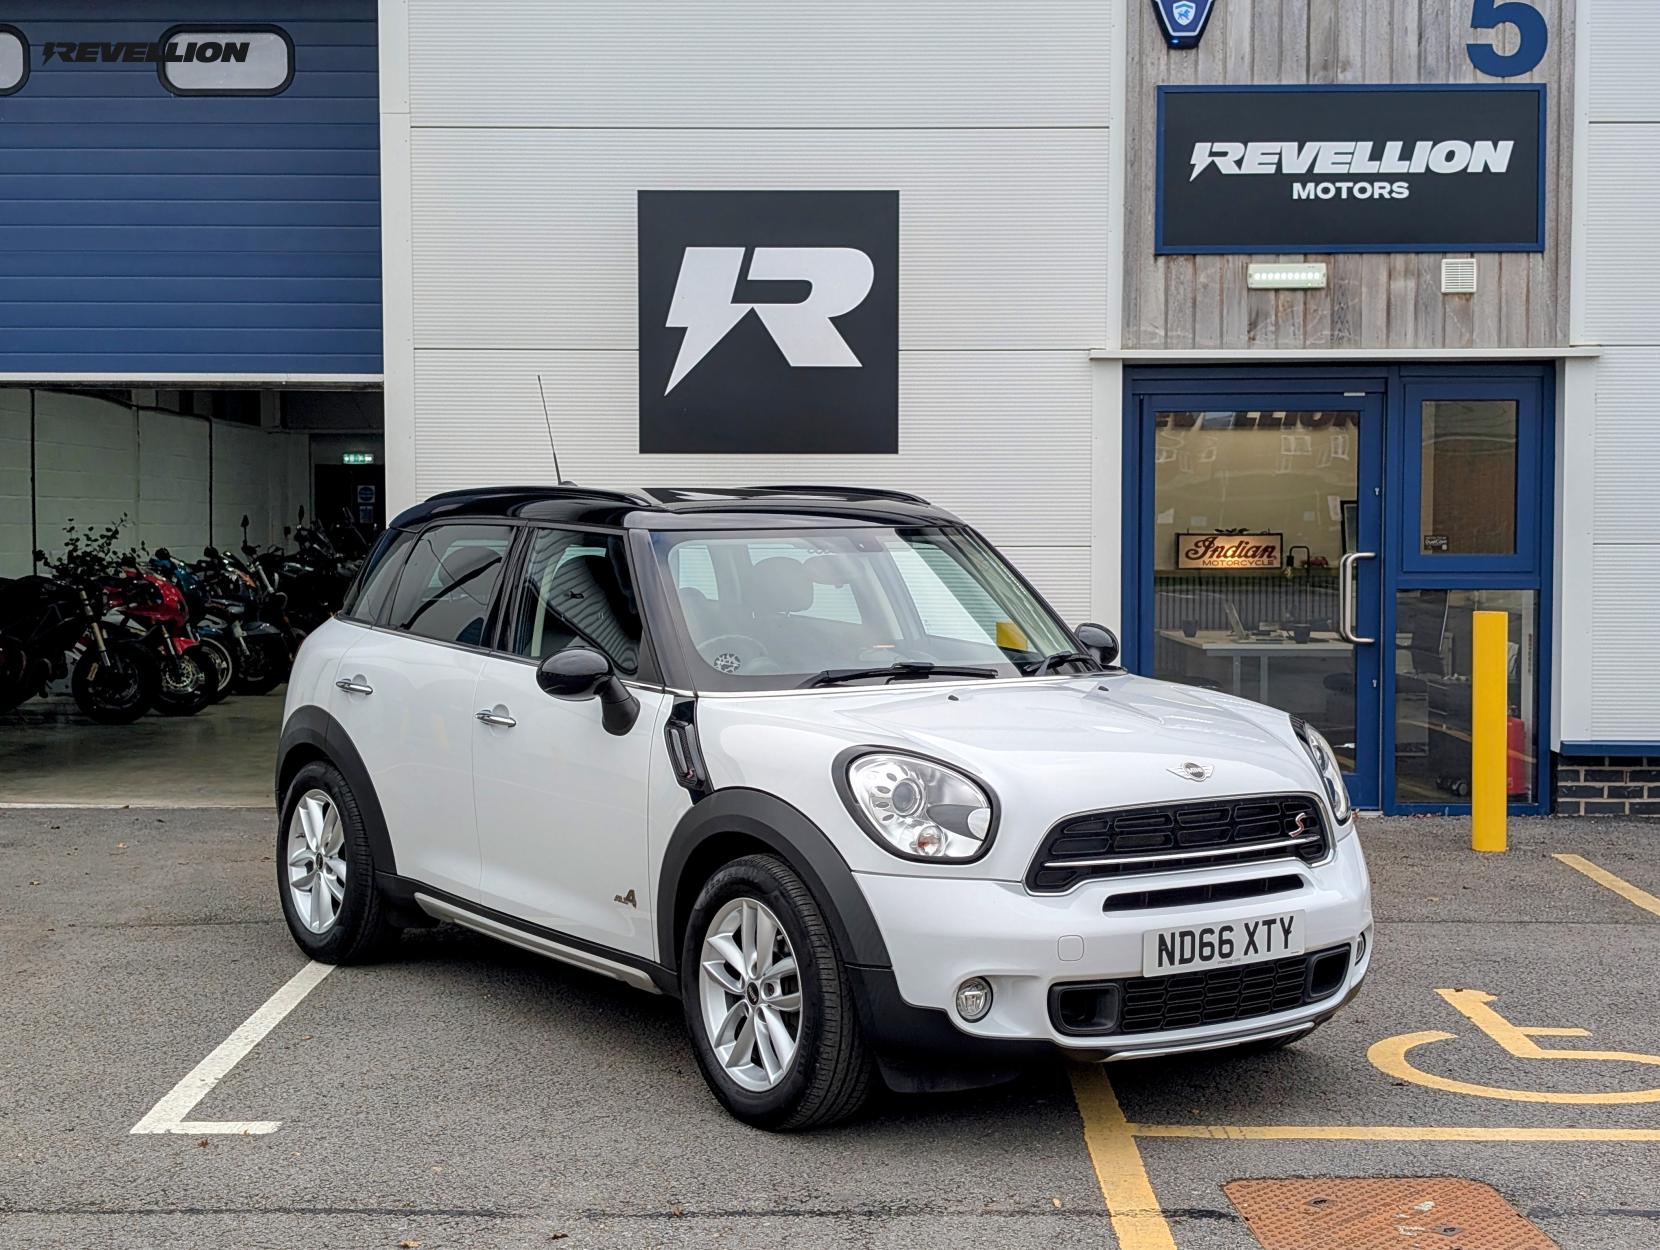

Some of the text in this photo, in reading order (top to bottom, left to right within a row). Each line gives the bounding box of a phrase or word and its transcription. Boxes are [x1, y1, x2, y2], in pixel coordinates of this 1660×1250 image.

[1466, 0, 1548, 77] 5
[1189, 140, 1514, 182] REVELLION
[1292, 181, 1410, 200] MOTORS
[1185, 536, 1277, 560] Indian
[1157, 915, 1294, 968] ND66 XTY
